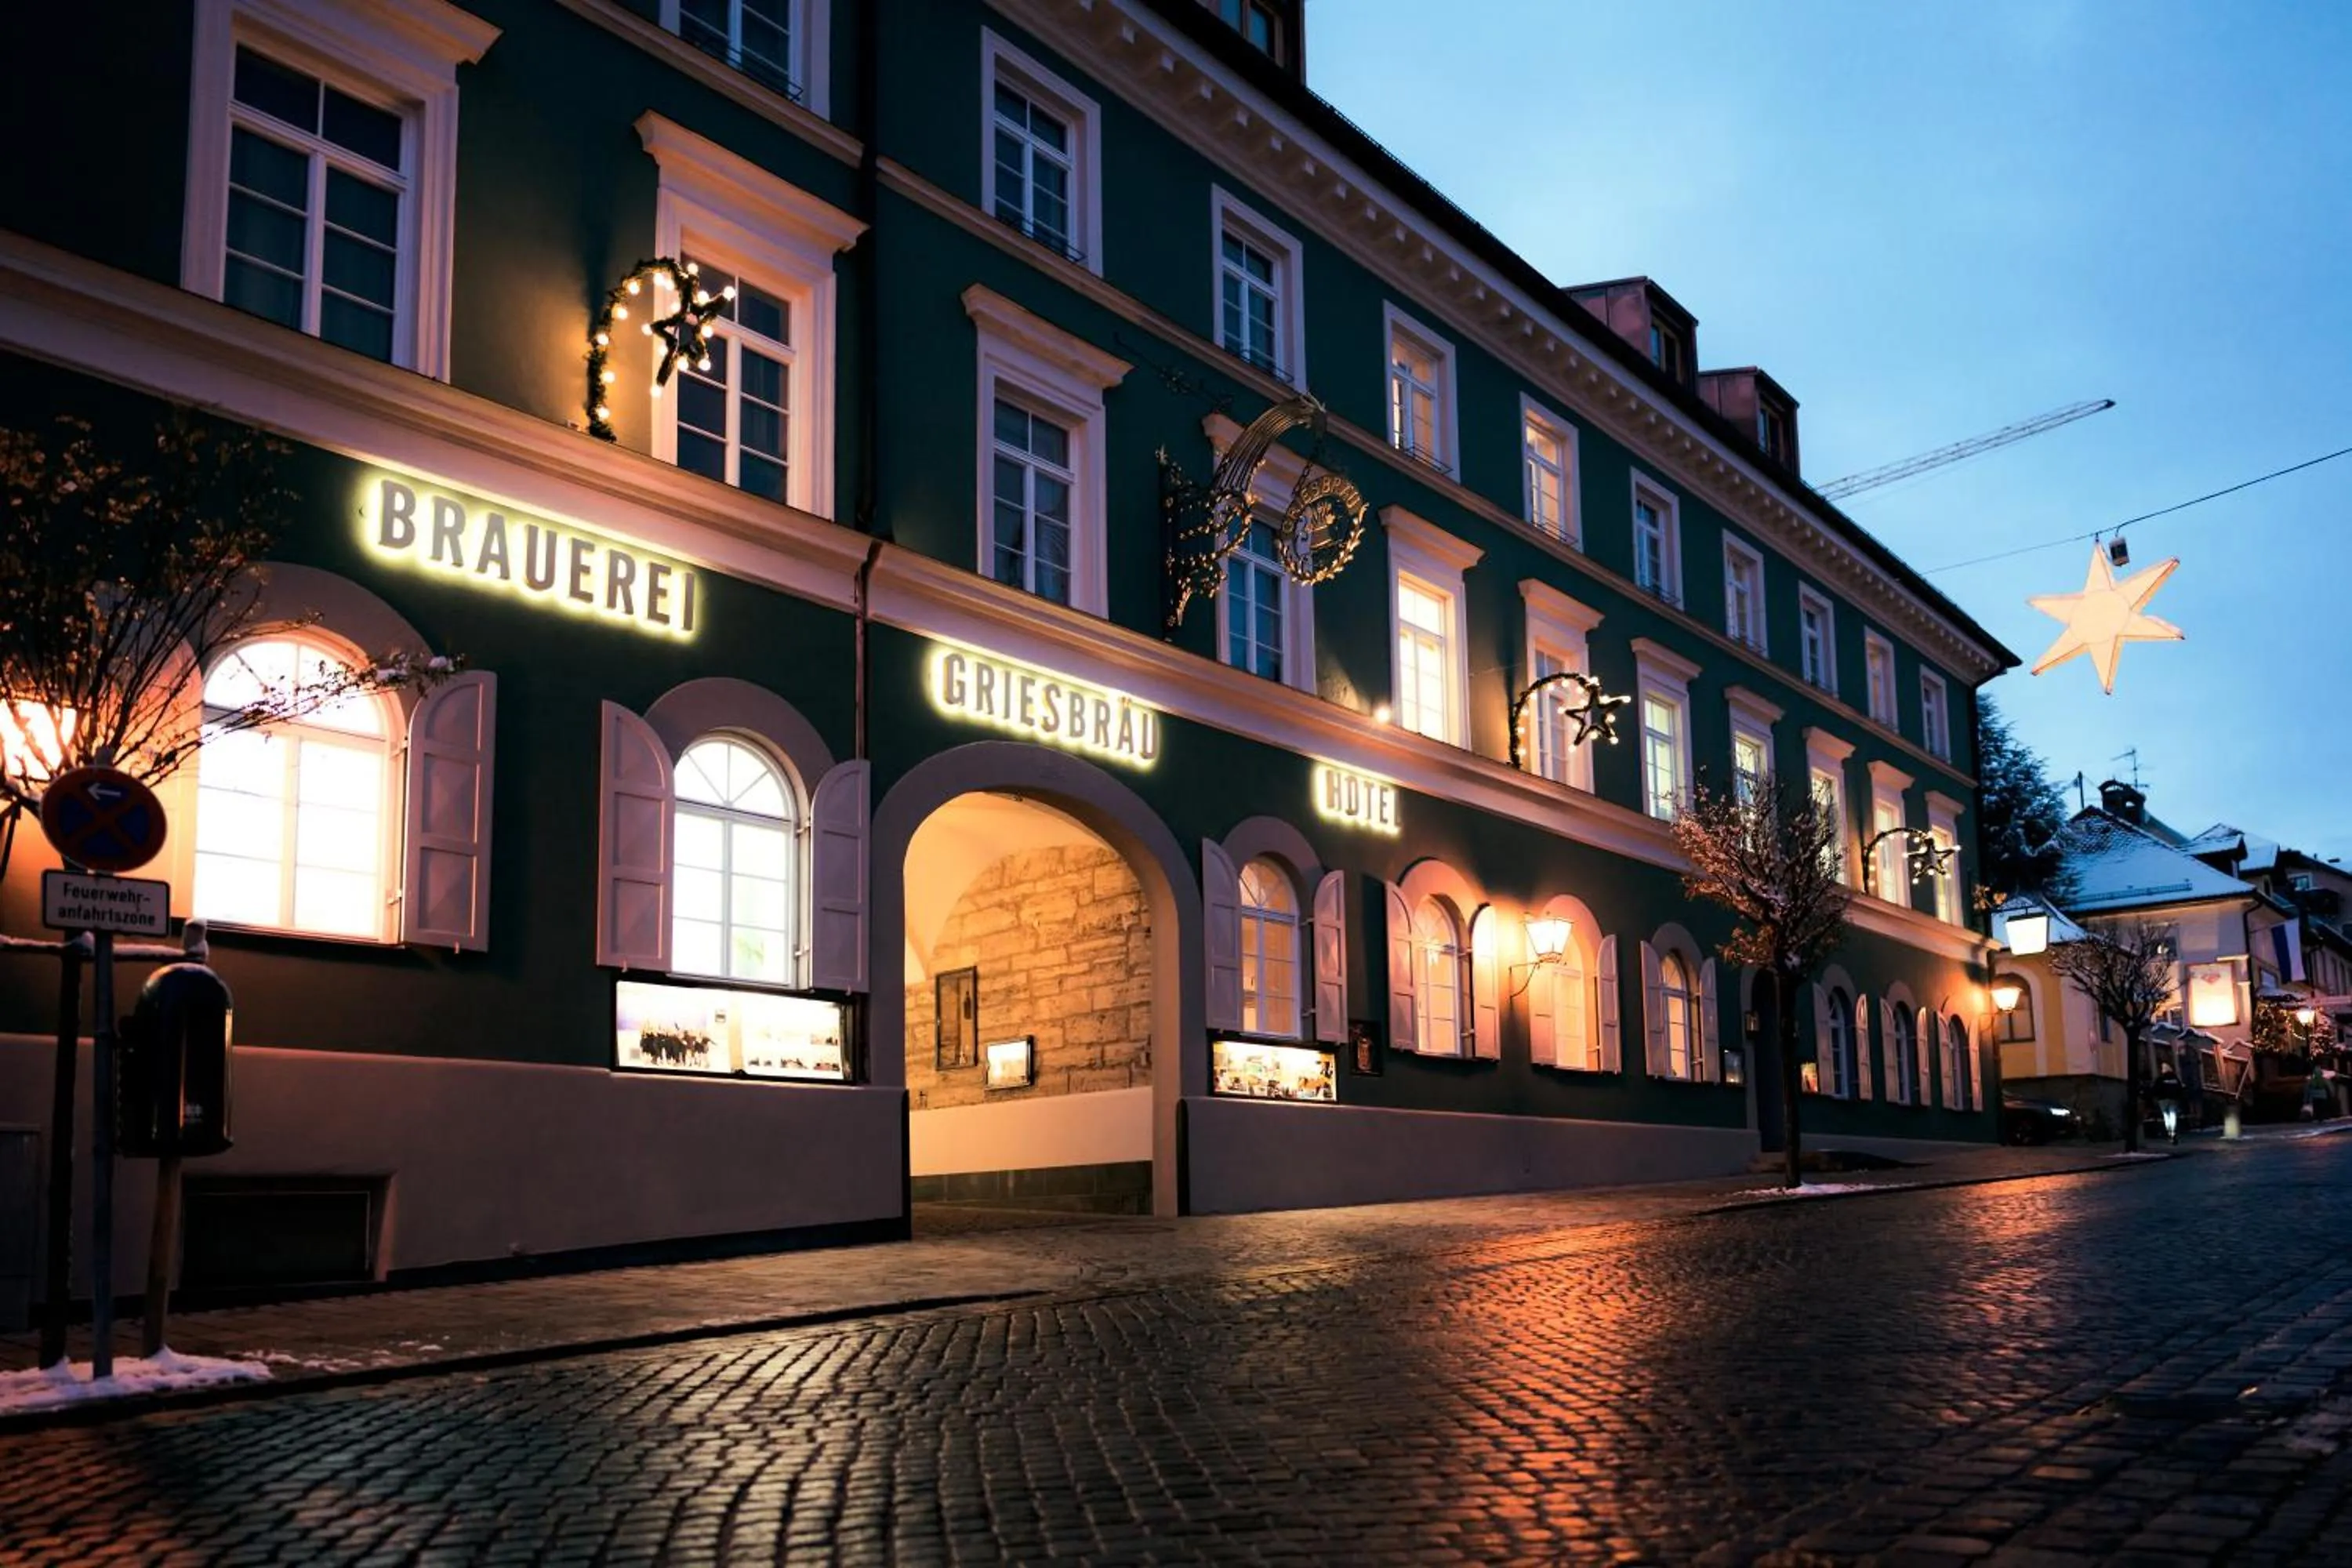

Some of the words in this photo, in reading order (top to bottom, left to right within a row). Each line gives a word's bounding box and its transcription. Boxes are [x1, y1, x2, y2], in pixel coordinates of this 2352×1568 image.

[378, 479, 695, 631] BRAUEREI
[943, 652, 1159, 760] GRIESBRÄU
[1325, 769, 1403, 826] HOTEL
[57, 905, 156, 926] anfahrtszone
[63, 881, 151, 903] Feuerwehr-
